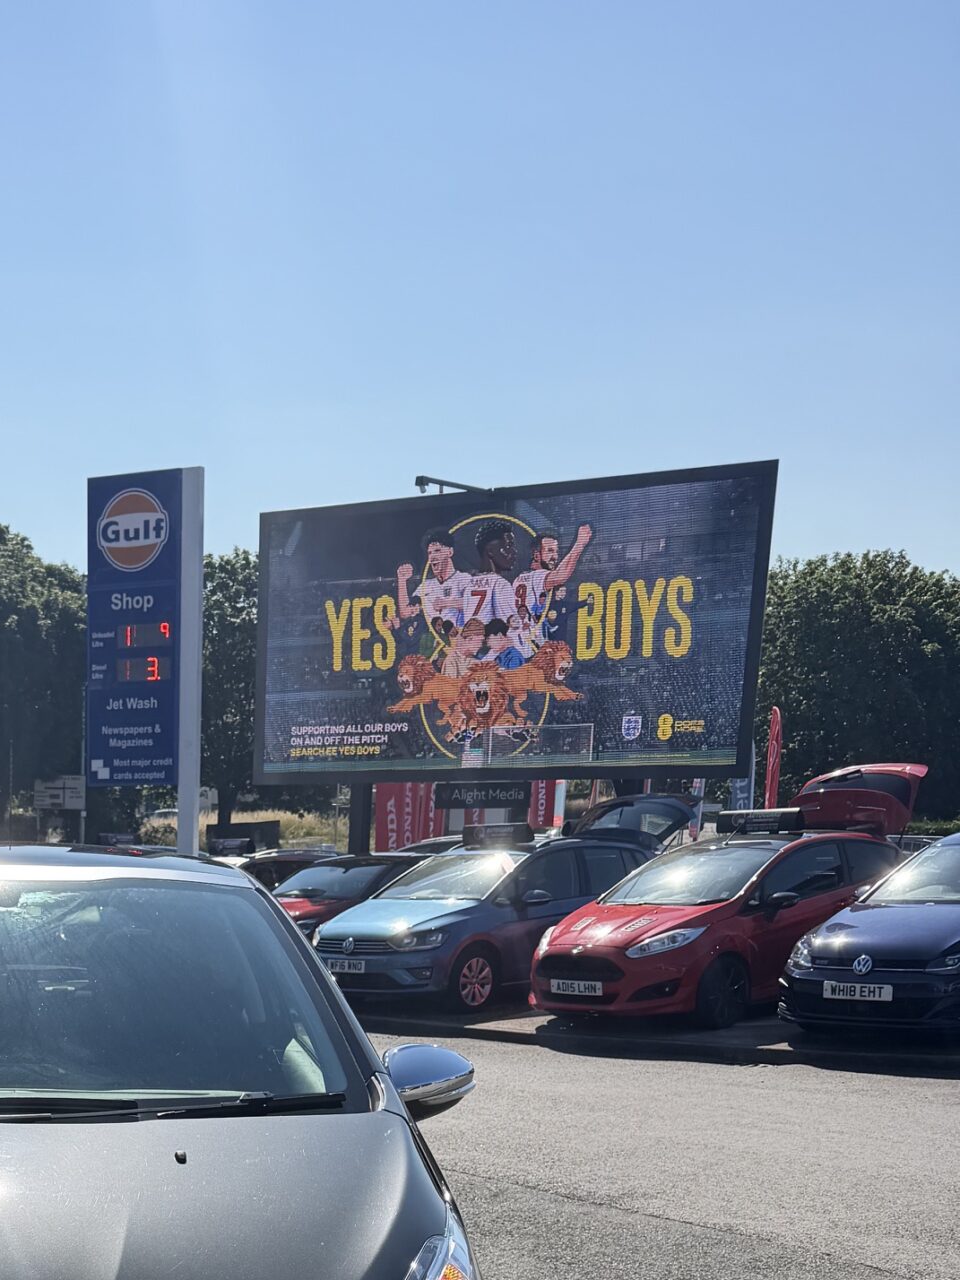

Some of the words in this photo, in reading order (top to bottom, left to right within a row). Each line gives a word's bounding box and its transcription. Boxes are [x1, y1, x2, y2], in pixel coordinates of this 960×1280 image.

[101, 517, 165, 544] Gulf
[111, 592, 154, 612] Shop
[514, 583, 528, 608] 9
[470, 589, 487, 617] 7
[325, 594, 398, 672] YES
[577, 575, 694, 661] BOYS
[106, 698, 123, 710] Jet
[126, 697, 158, 710] Wash
[101, 725, 153, 736] Newspapers
[154, 724, 162, 733] &
[291, 725, 345, 736] SUPPORTING
[346, 724, 363, 733] ALL
[364, 723, 383, 733] OUR
[384, 722, 409, 732] BOYS
[109, 738, 154, 749] Magazines
[290, 737, 303, 746] ON
[304, 736, 323, 746] AND
[324, 736, 342, 745] OFF
[342, 735, 361, 745] THE
[361, 734, 389, 744] PITCH
[290, 747, 327, 757] SEARCH
[327, 746, 338, 756] EE
[338, 746, 356, 756] YES
[356, 745, 381, 755] BOYS
[113, 758, 130, 767] Most
[131, 758, 151, 768] major
[152, 758, 173, 766] credit
[113, 772, 132, 780] cards
[134, 771, 165, 781] accepted
[451, 788, 486, 804] Alight
[488, 788, 525, 801] Media
[386, 797, 398, 849] NDA
[556, 980, 576, 993] AD15
[577, 981, 597, 994] LHN
[830, 984, 856, 997] WH18
[859, 985, 885, 998] EHT
